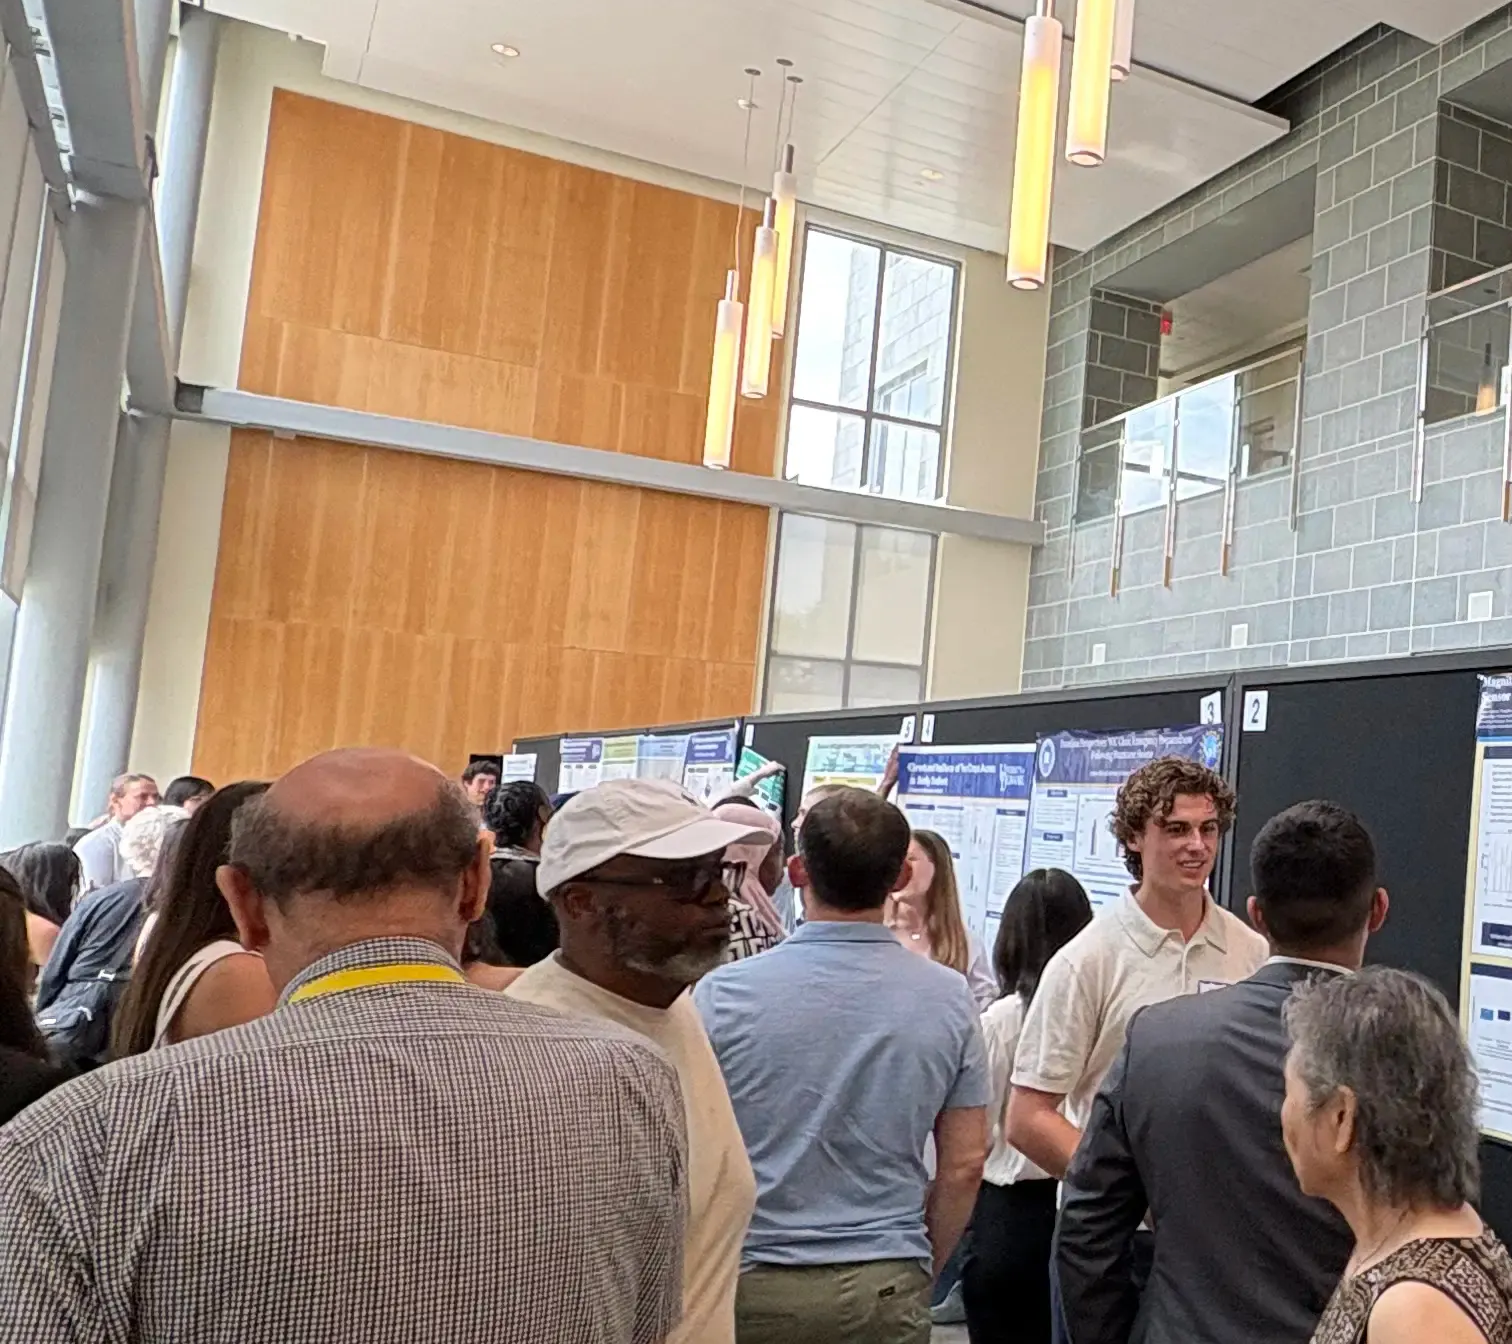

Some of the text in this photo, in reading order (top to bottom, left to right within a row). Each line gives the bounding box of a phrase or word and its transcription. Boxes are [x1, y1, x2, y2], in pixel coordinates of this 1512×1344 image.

[1481, 691, 1512, 704] Sensor
[1207, 701, 1215, 724] 3
[1251, 698, 1261, 724] 2
